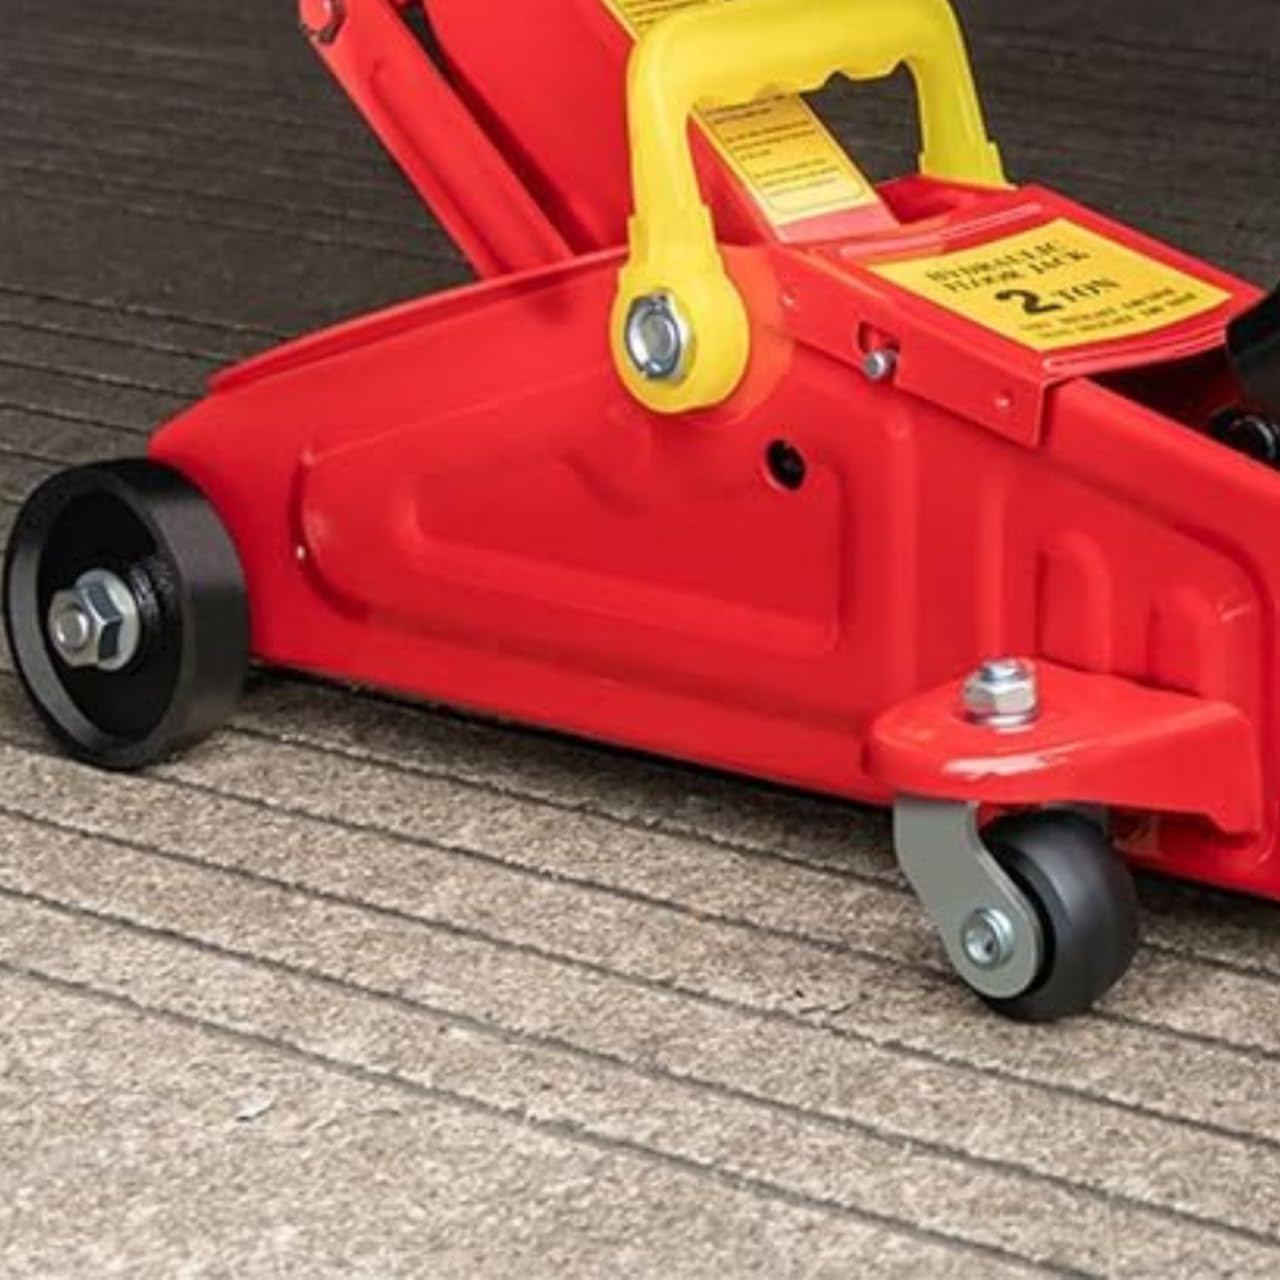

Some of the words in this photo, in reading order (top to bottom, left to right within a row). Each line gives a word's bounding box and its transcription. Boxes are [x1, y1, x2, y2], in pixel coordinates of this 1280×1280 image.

[1029, 250, 1091, 275] JACK
[994, 288, 1064, 316] 2
[1051, 277, 1121, 302] TON
